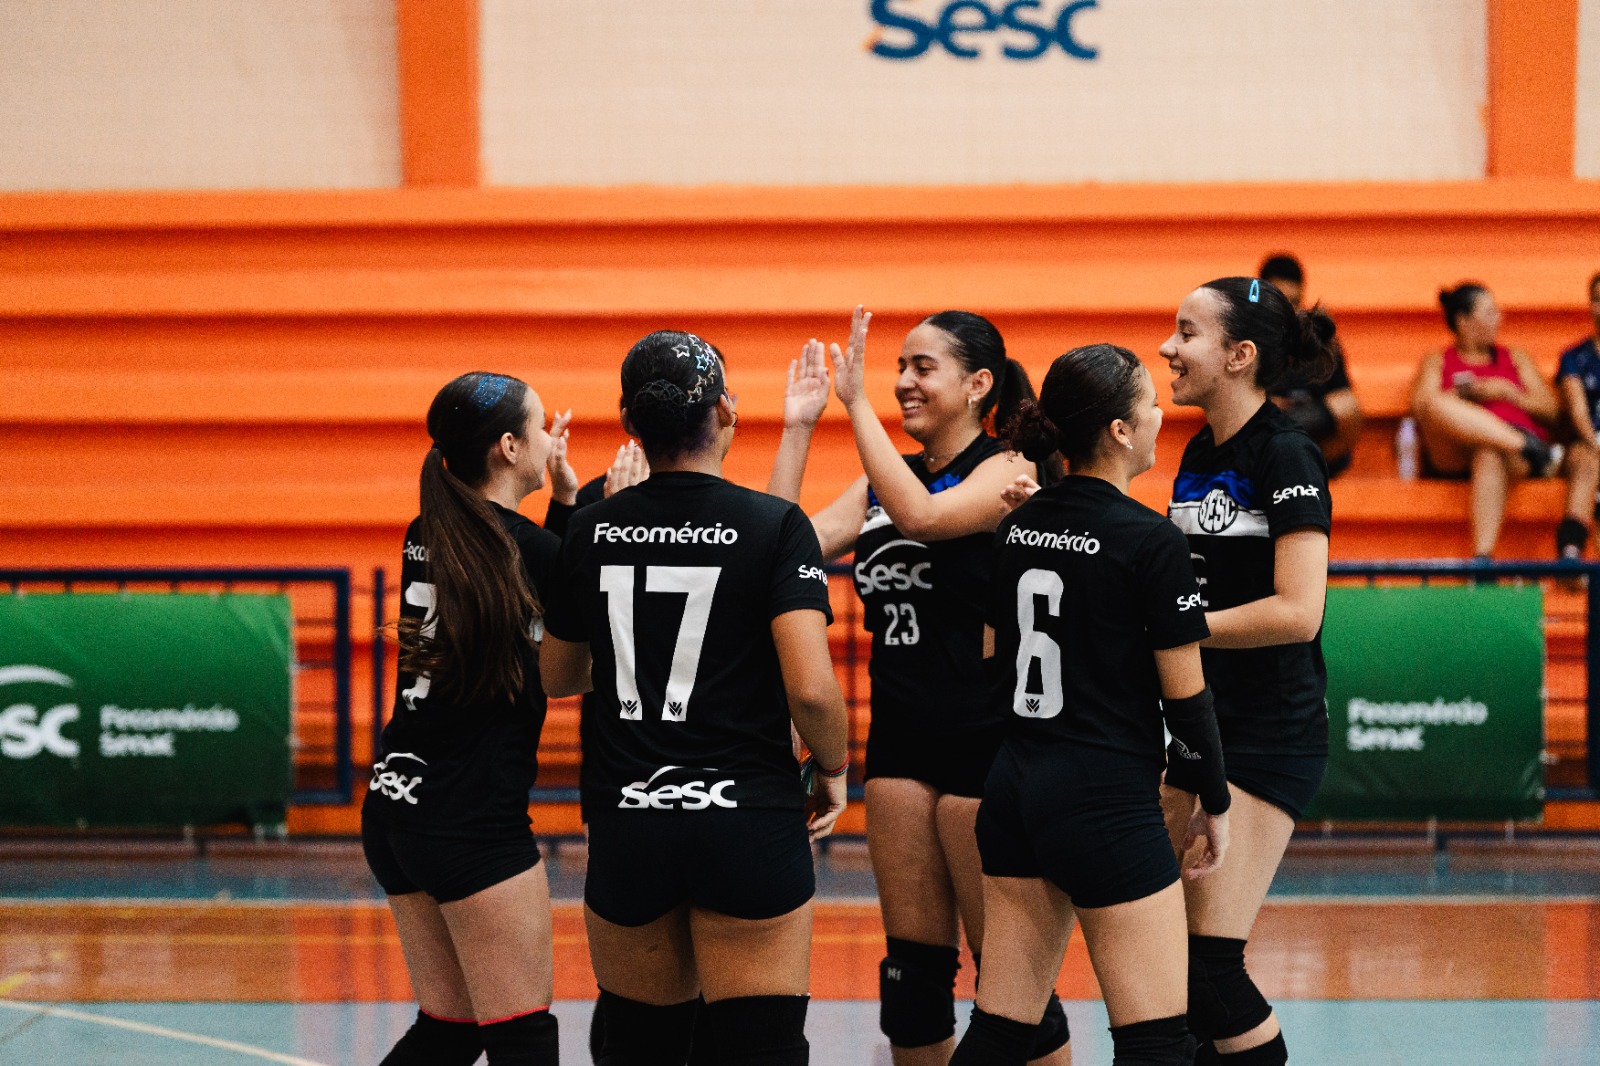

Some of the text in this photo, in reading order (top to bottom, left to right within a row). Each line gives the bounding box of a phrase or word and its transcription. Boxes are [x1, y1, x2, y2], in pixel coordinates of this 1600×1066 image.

[593, 521, 738, 545] Fecomércio
[600, 565, 722, 721] 17
[883, 602, 920, 646] 23
[1013, 568, 1064, 719] 6
